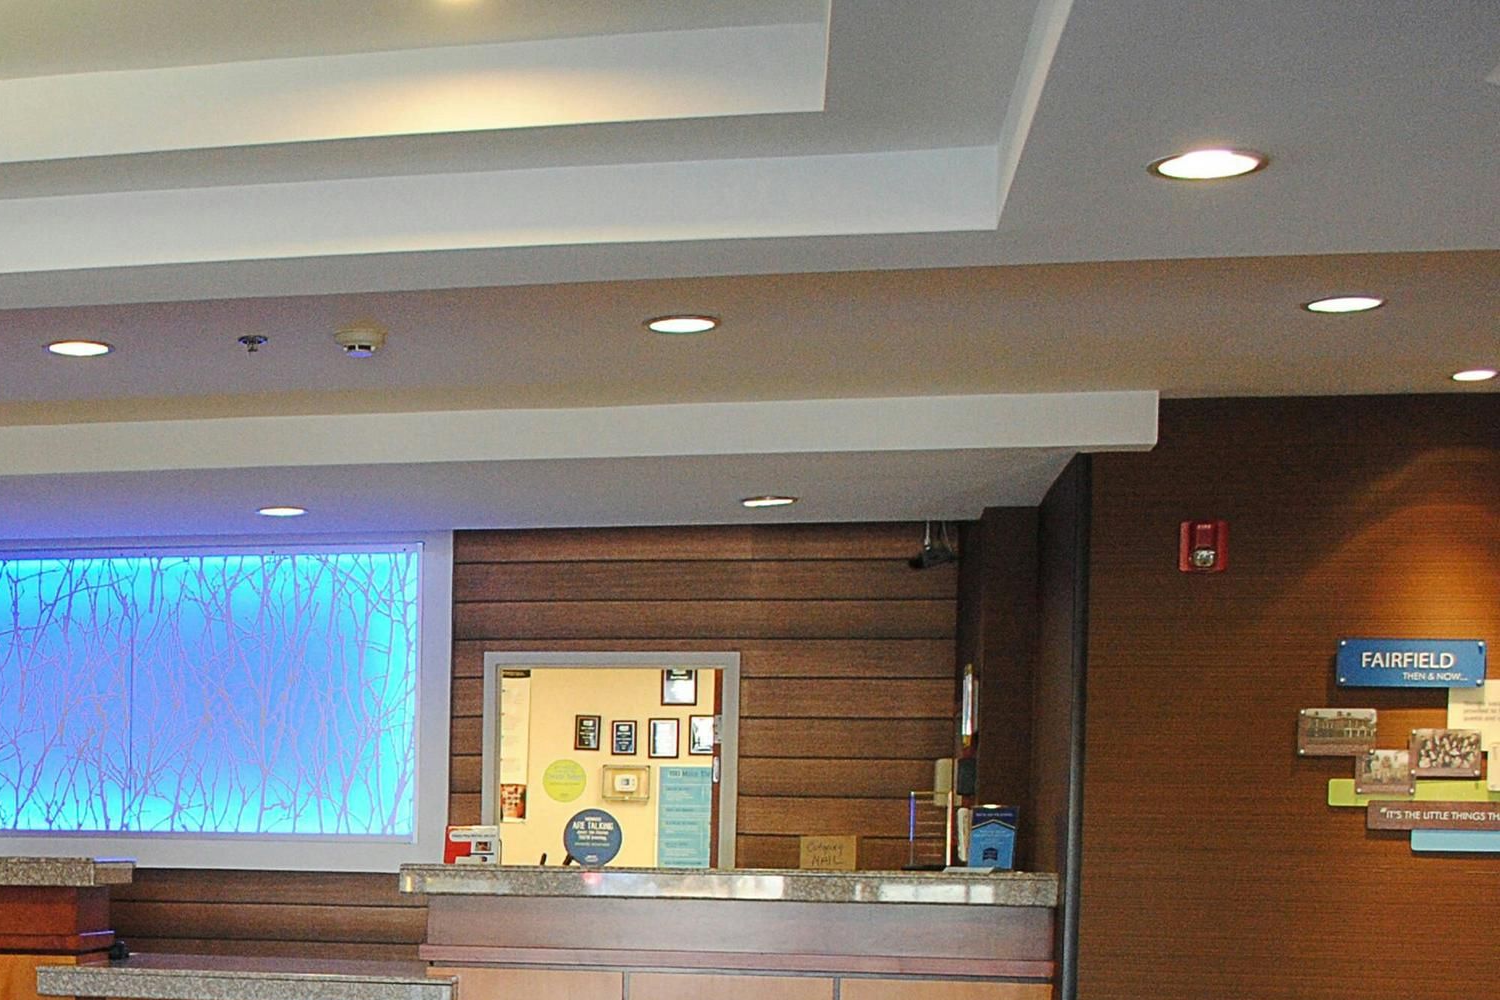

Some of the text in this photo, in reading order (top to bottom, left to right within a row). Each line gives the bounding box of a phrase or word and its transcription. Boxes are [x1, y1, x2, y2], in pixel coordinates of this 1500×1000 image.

[1361, 651, 1455, 669] FAIRFIELD
[1403, 672, 1426, 681] THEN
[1427, 672, 1435, 681] &
[1404, 810, 1421, 820] THE
[1423, 810, 1449, 821] LITTLE
[1451, 811, 1486, 822] THINGS
